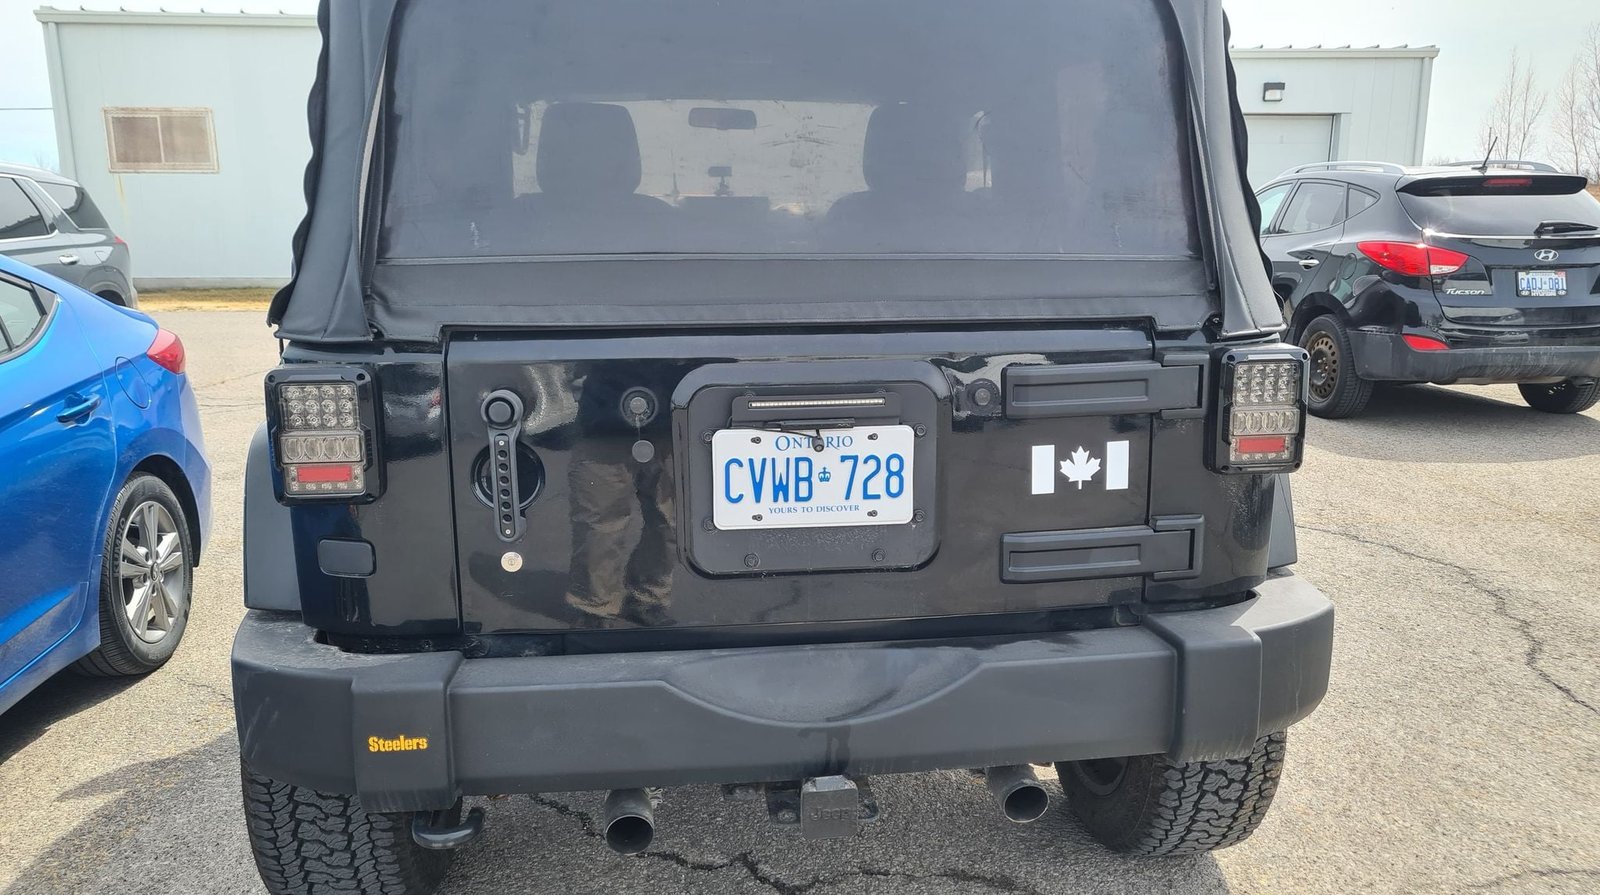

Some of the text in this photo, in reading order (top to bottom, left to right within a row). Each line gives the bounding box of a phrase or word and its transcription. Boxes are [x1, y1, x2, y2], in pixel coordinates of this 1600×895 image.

[1446, 287, 1486, 296] Tucson
[775, 435, 853, 451] ONTRIO
[724, 453, 905, 504] CVWB 728
[768, 506, 798, 514] YOURS
[816, 504, 860, 513] DISCOVER
[368, 735, 428, 752] Steelers
